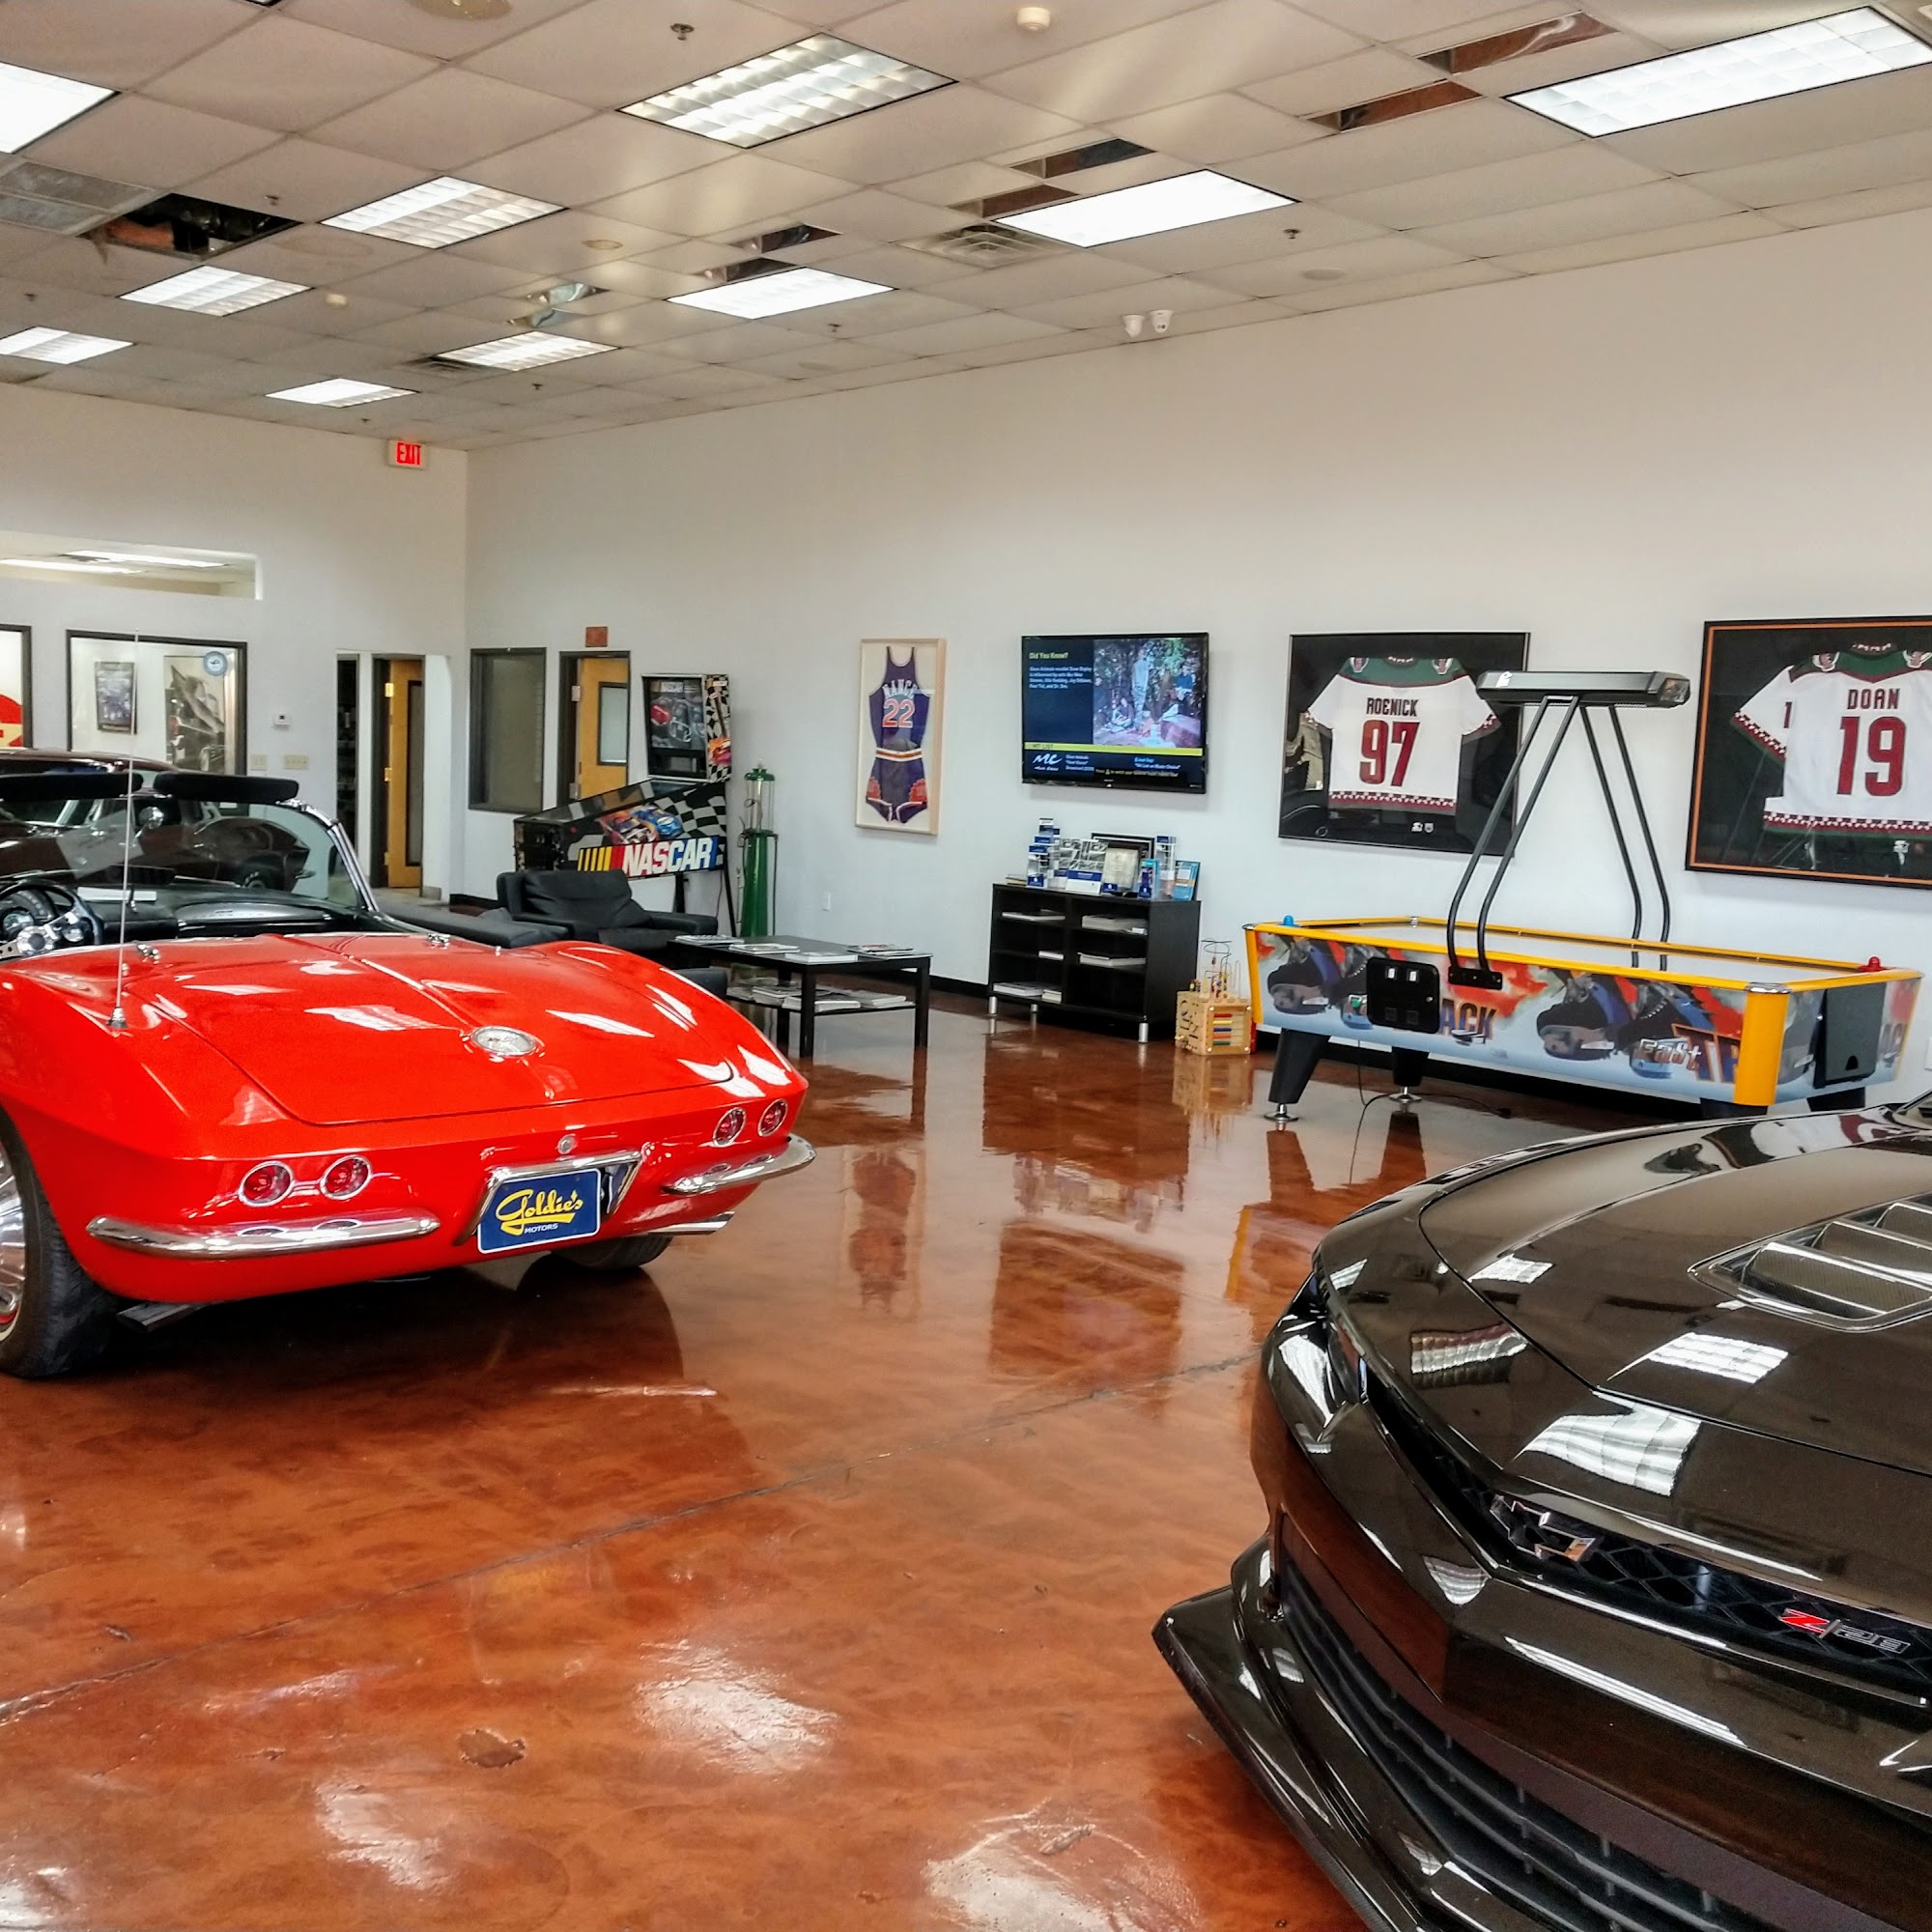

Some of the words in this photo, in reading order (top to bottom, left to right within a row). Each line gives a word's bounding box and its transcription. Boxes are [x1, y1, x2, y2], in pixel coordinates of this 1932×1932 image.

[396, 441, 421, 465] EXIT
[882, 698, 915, 728] 22
[1366, 697, 1419, 717] ROENICK
[1847, 689, 1900, 710] DOAN
[1359, 720, 1420, 787] 97
[1836, 716, 1906, 797] 19
[622, 838, 713, 877] NASCAR
[496, 1188, 583, 1236] Goldie's
[524, 1223, 558, 1235] MOTORS
